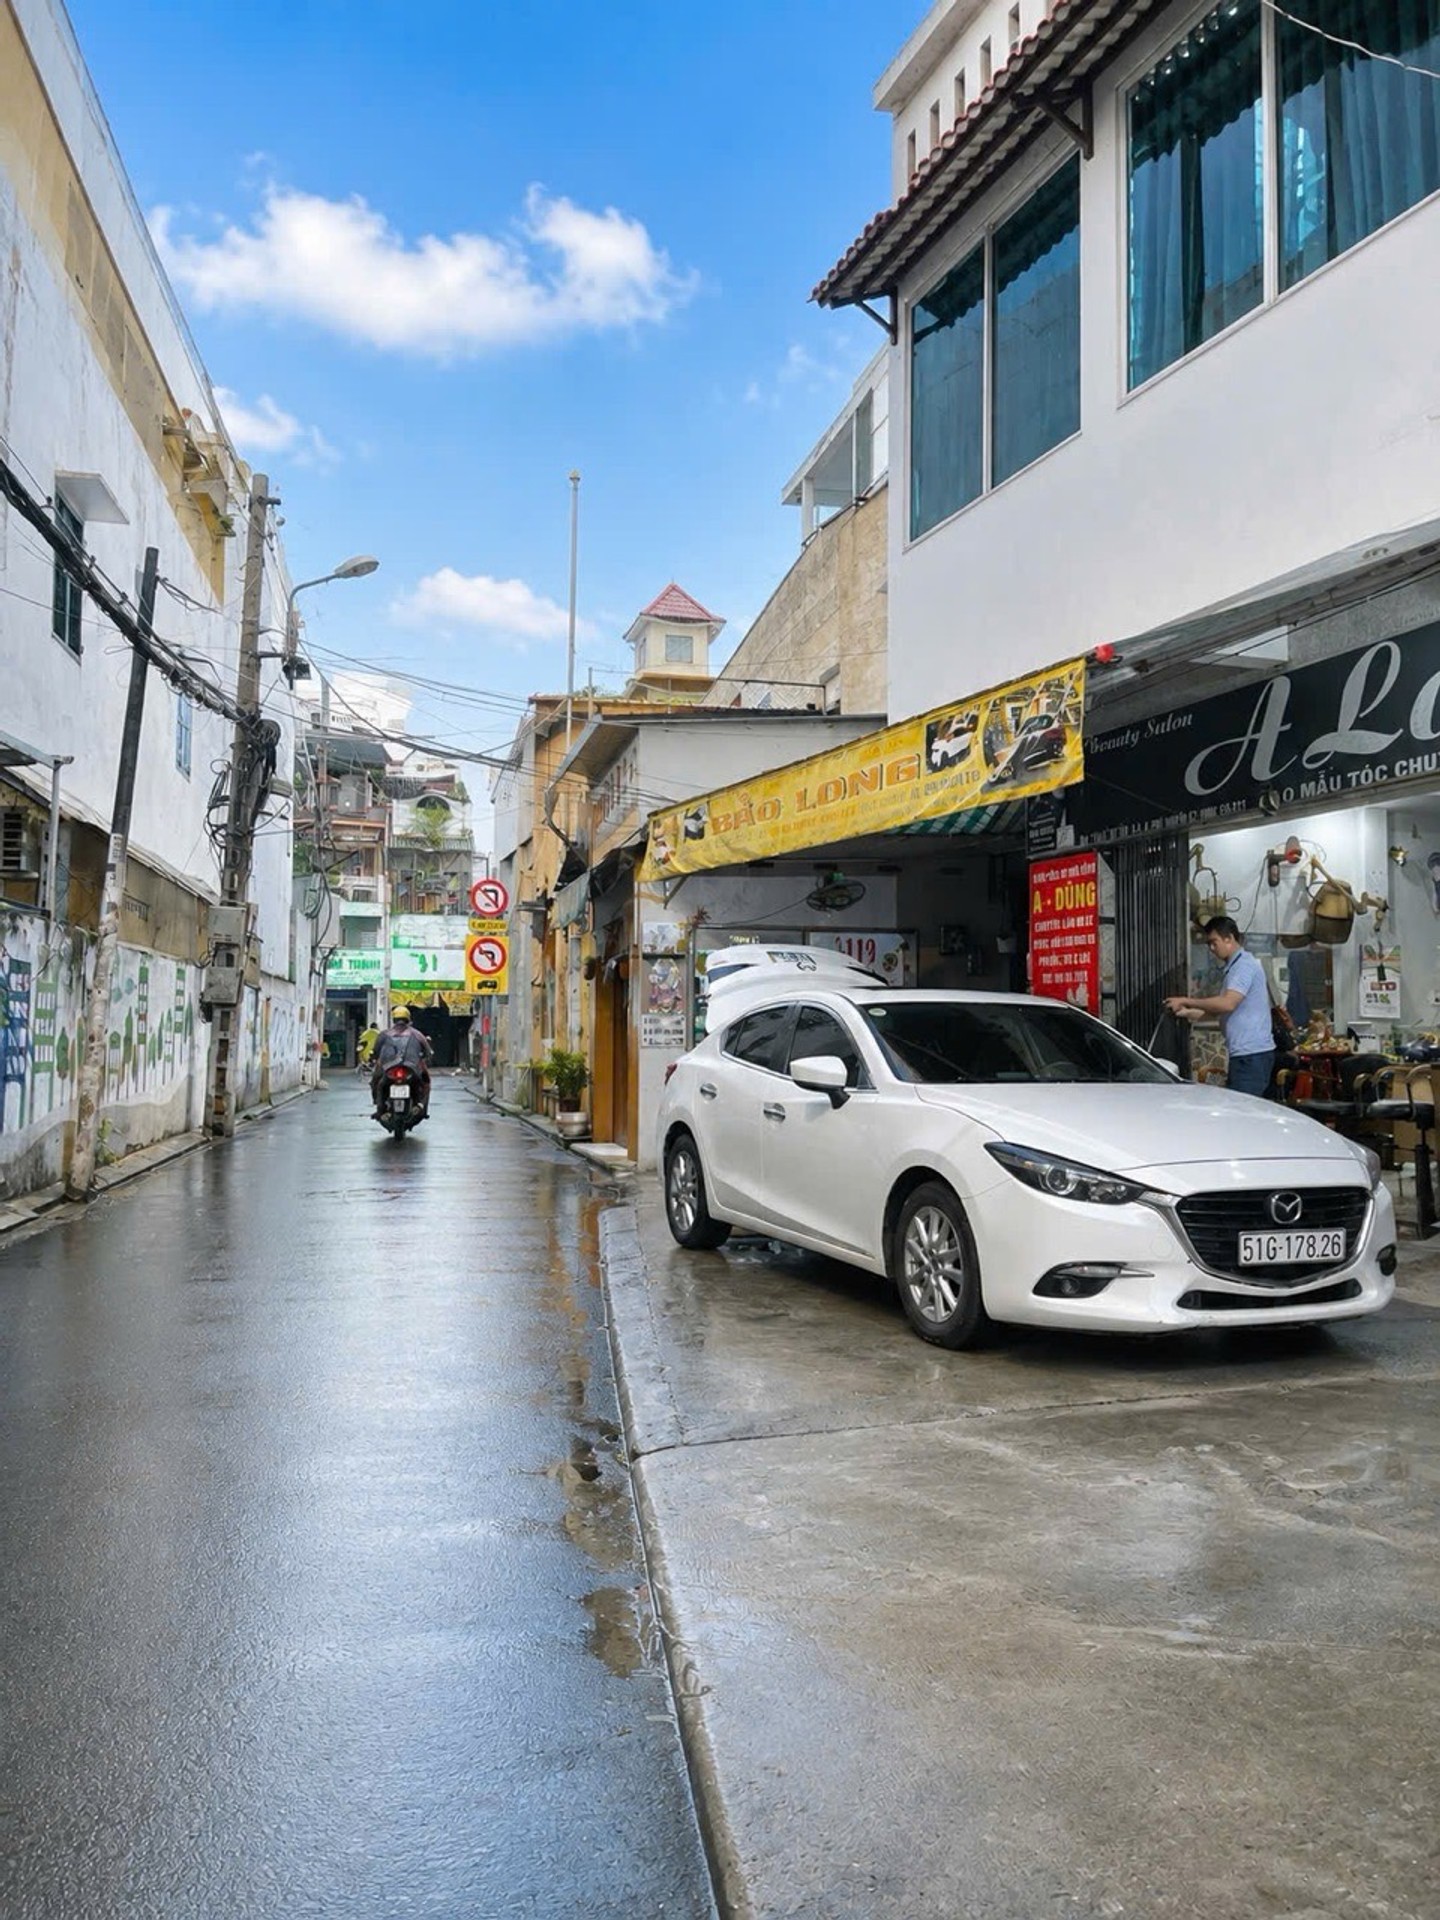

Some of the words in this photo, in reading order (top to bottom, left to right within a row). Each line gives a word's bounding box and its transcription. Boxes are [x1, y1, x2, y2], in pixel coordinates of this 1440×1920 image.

[1394, 750, 1440, 778] CHU
[795, 753, 921, 813] LONG
[1243, 1234, 1341, 1262] 51G-178.26
